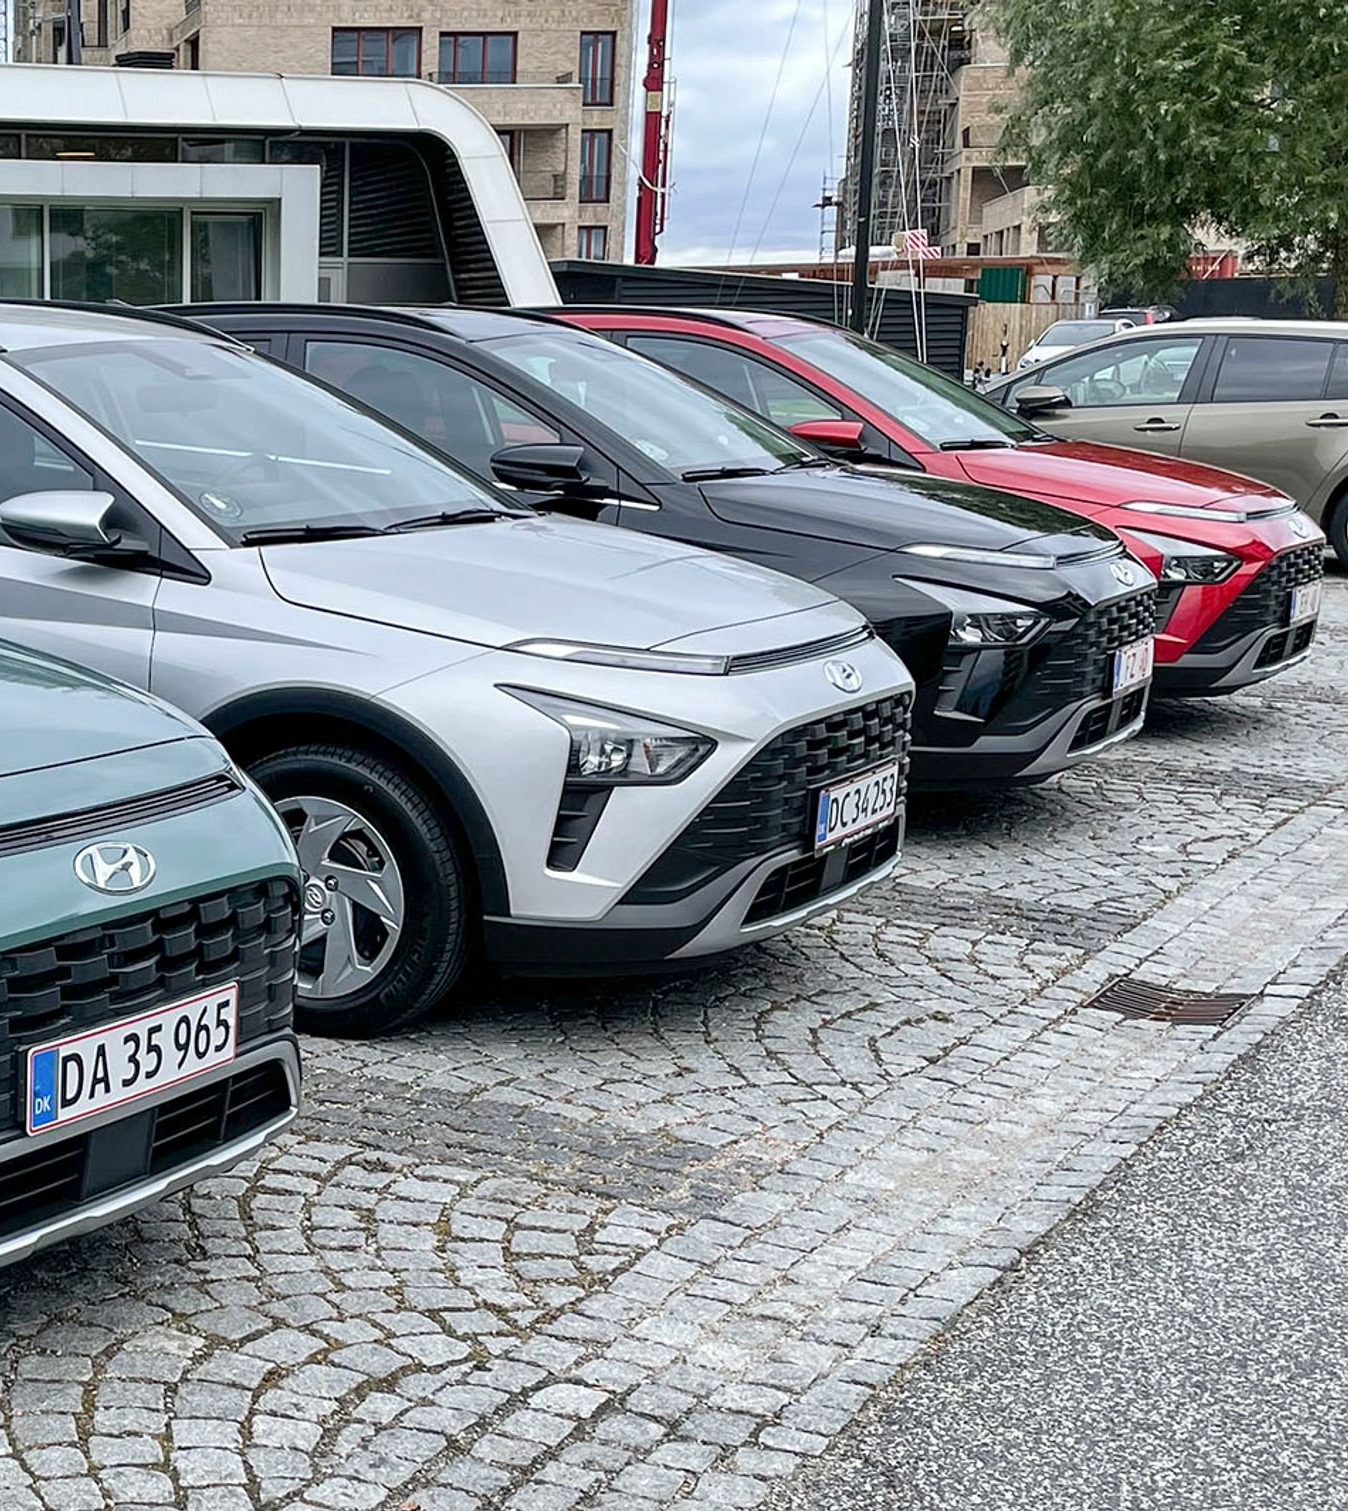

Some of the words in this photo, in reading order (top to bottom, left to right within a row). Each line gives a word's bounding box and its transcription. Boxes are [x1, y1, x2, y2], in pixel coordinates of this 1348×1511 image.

[829, 792, 850, 833] DC
[852, 784, 870, 823] 34
[871, 773, 895, 815] 253
[60, 1043, 111, 1109] DA
[121, 1024, 163, 1088] 35
[174, 1000, 230, 1069] 965
[34, 1096, 51, 1115] DK
